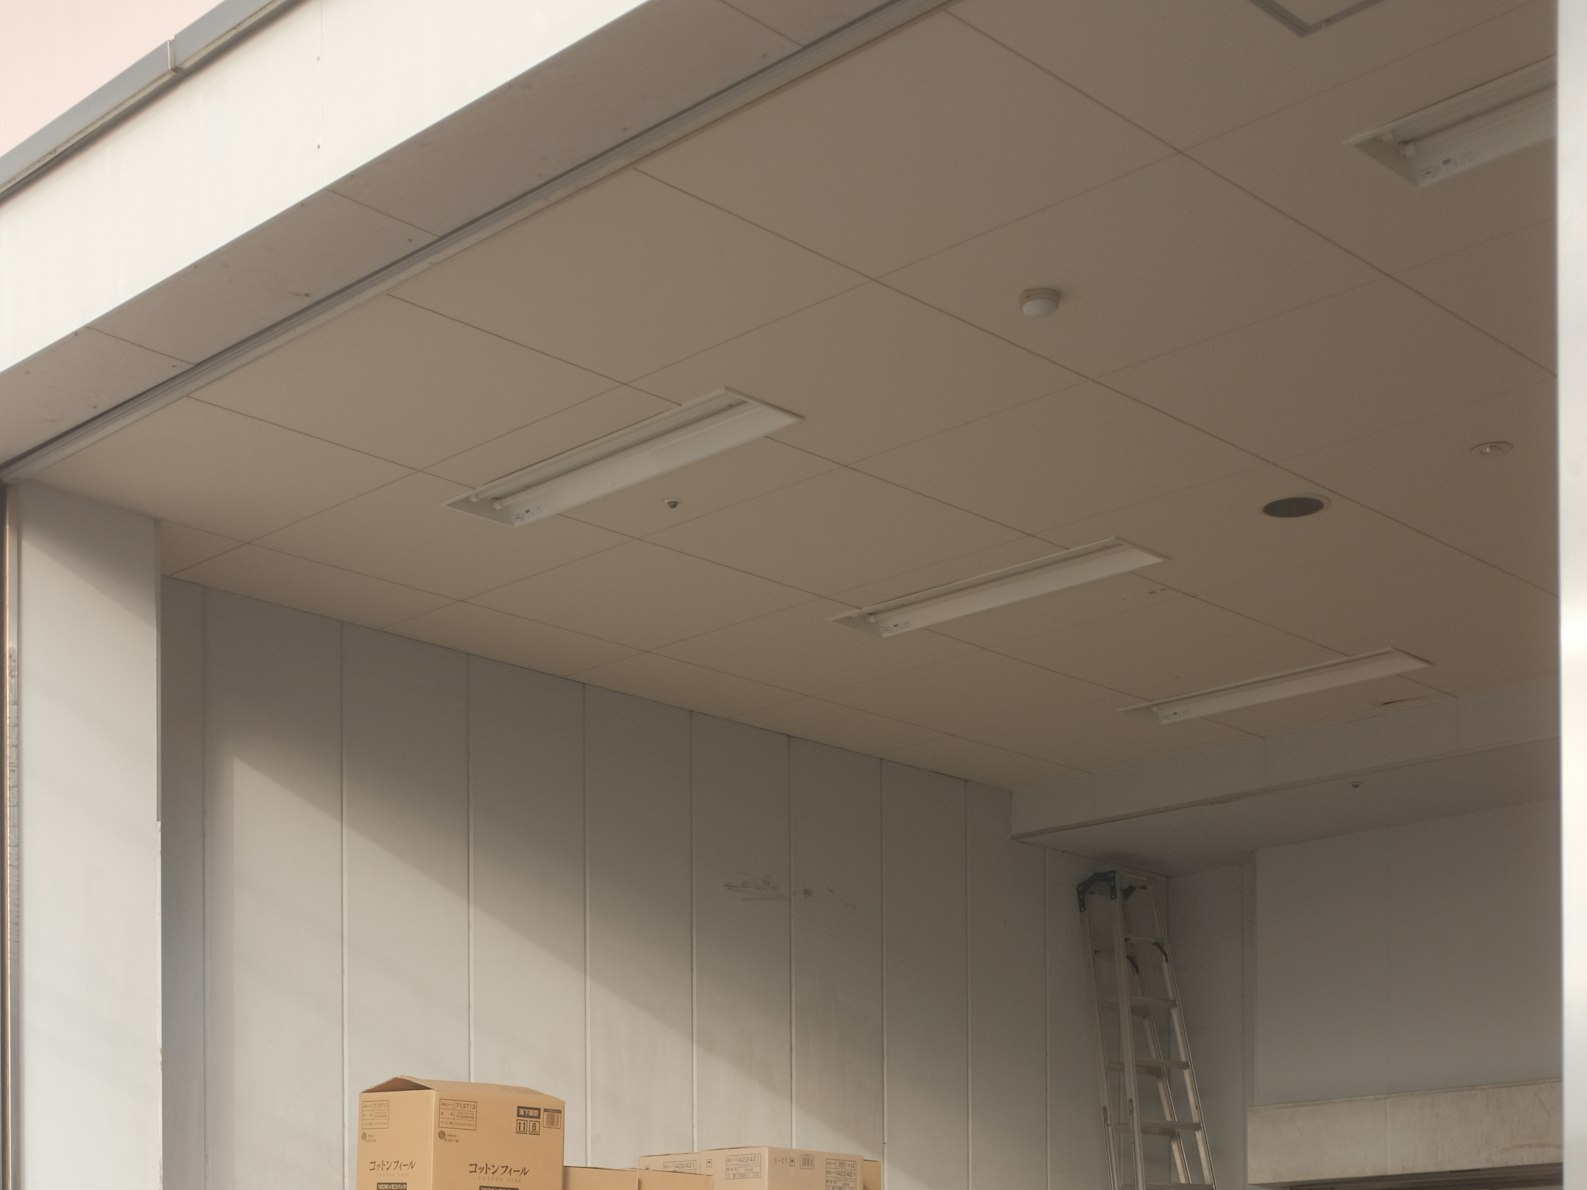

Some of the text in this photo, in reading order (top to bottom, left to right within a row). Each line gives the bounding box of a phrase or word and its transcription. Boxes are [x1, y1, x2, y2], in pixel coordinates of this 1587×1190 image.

[369, 1160, 416, 1171] コットンフィール
[469, 1162, 530, 1176] コットンフィール
